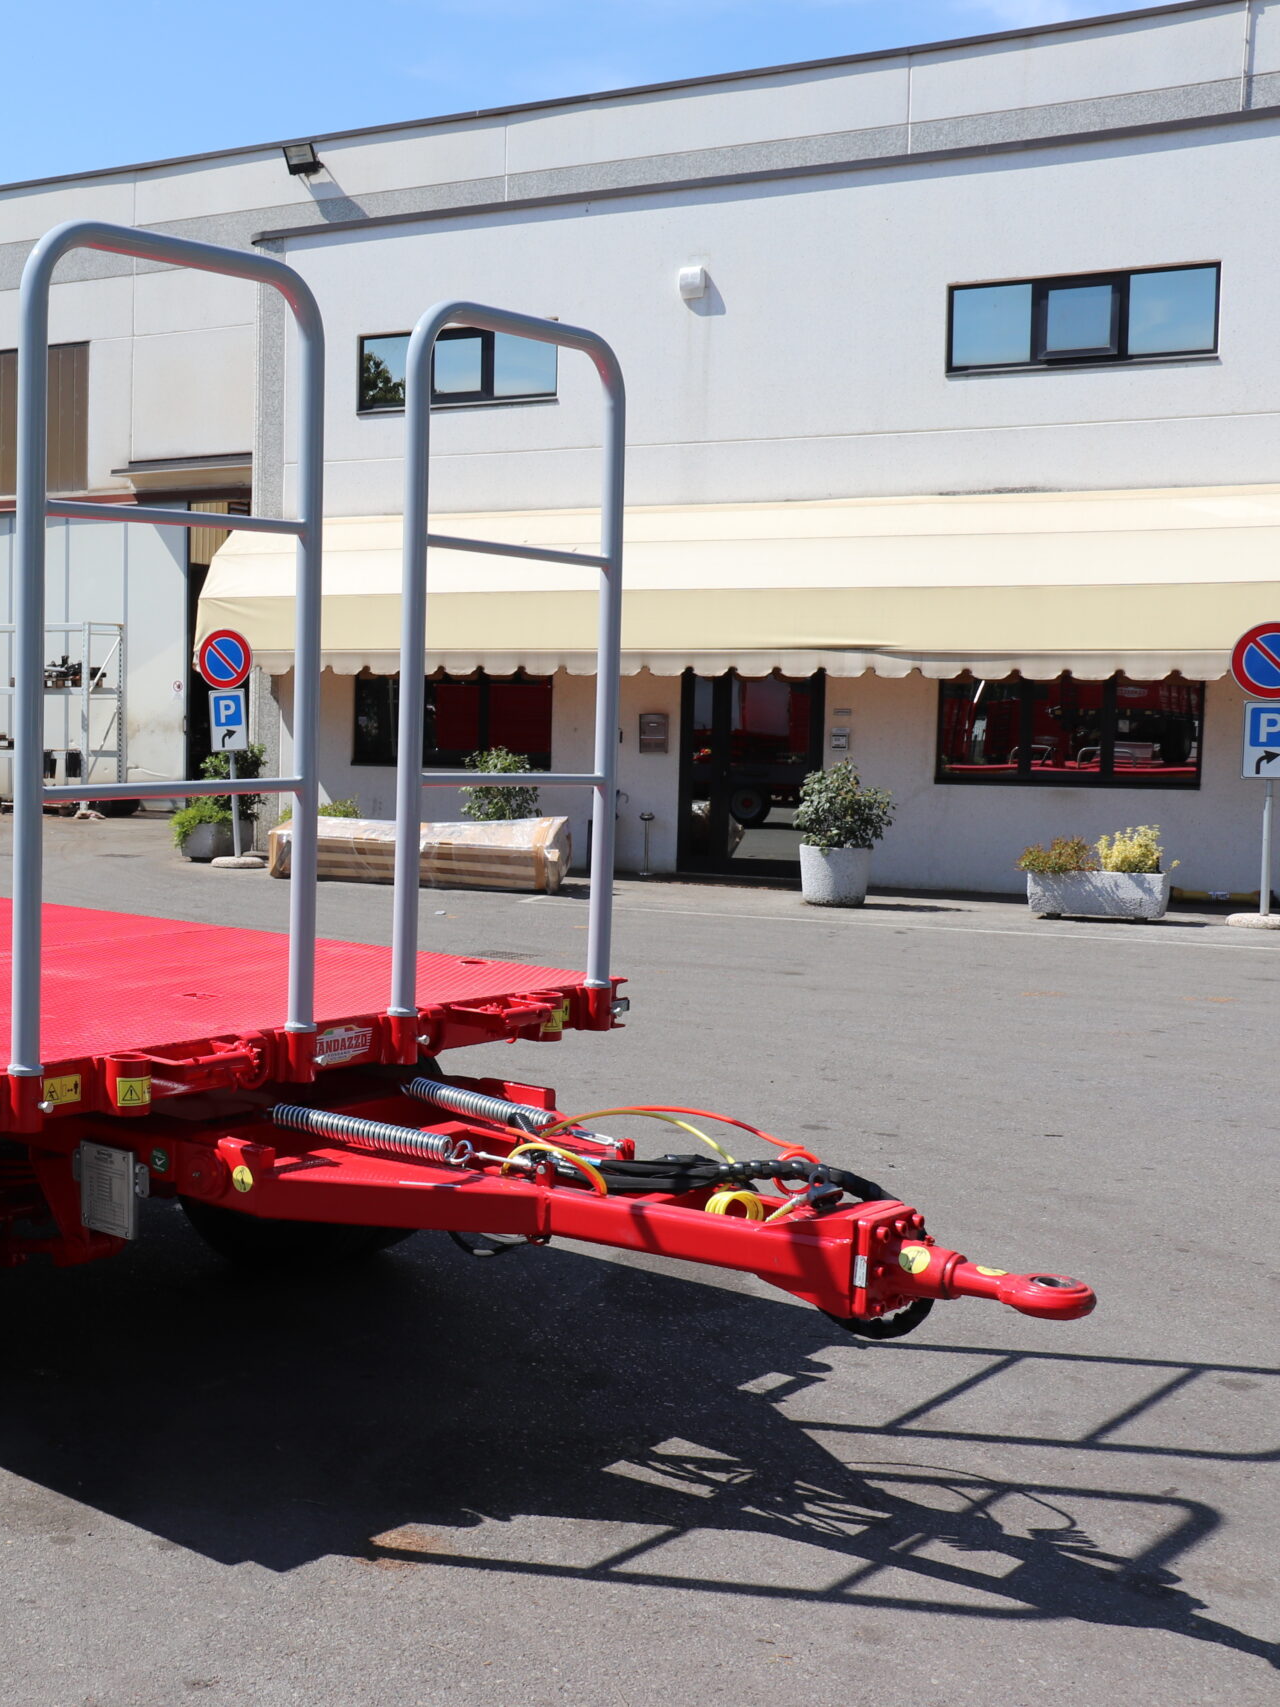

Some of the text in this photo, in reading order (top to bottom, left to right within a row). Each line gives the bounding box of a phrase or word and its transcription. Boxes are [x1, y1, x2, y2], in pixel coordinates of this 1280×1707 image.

[219, 700, 236, 724] P
[1259, 712, 1280, 743] P
[317, 1034, 368, 1056] ANDAZZO
